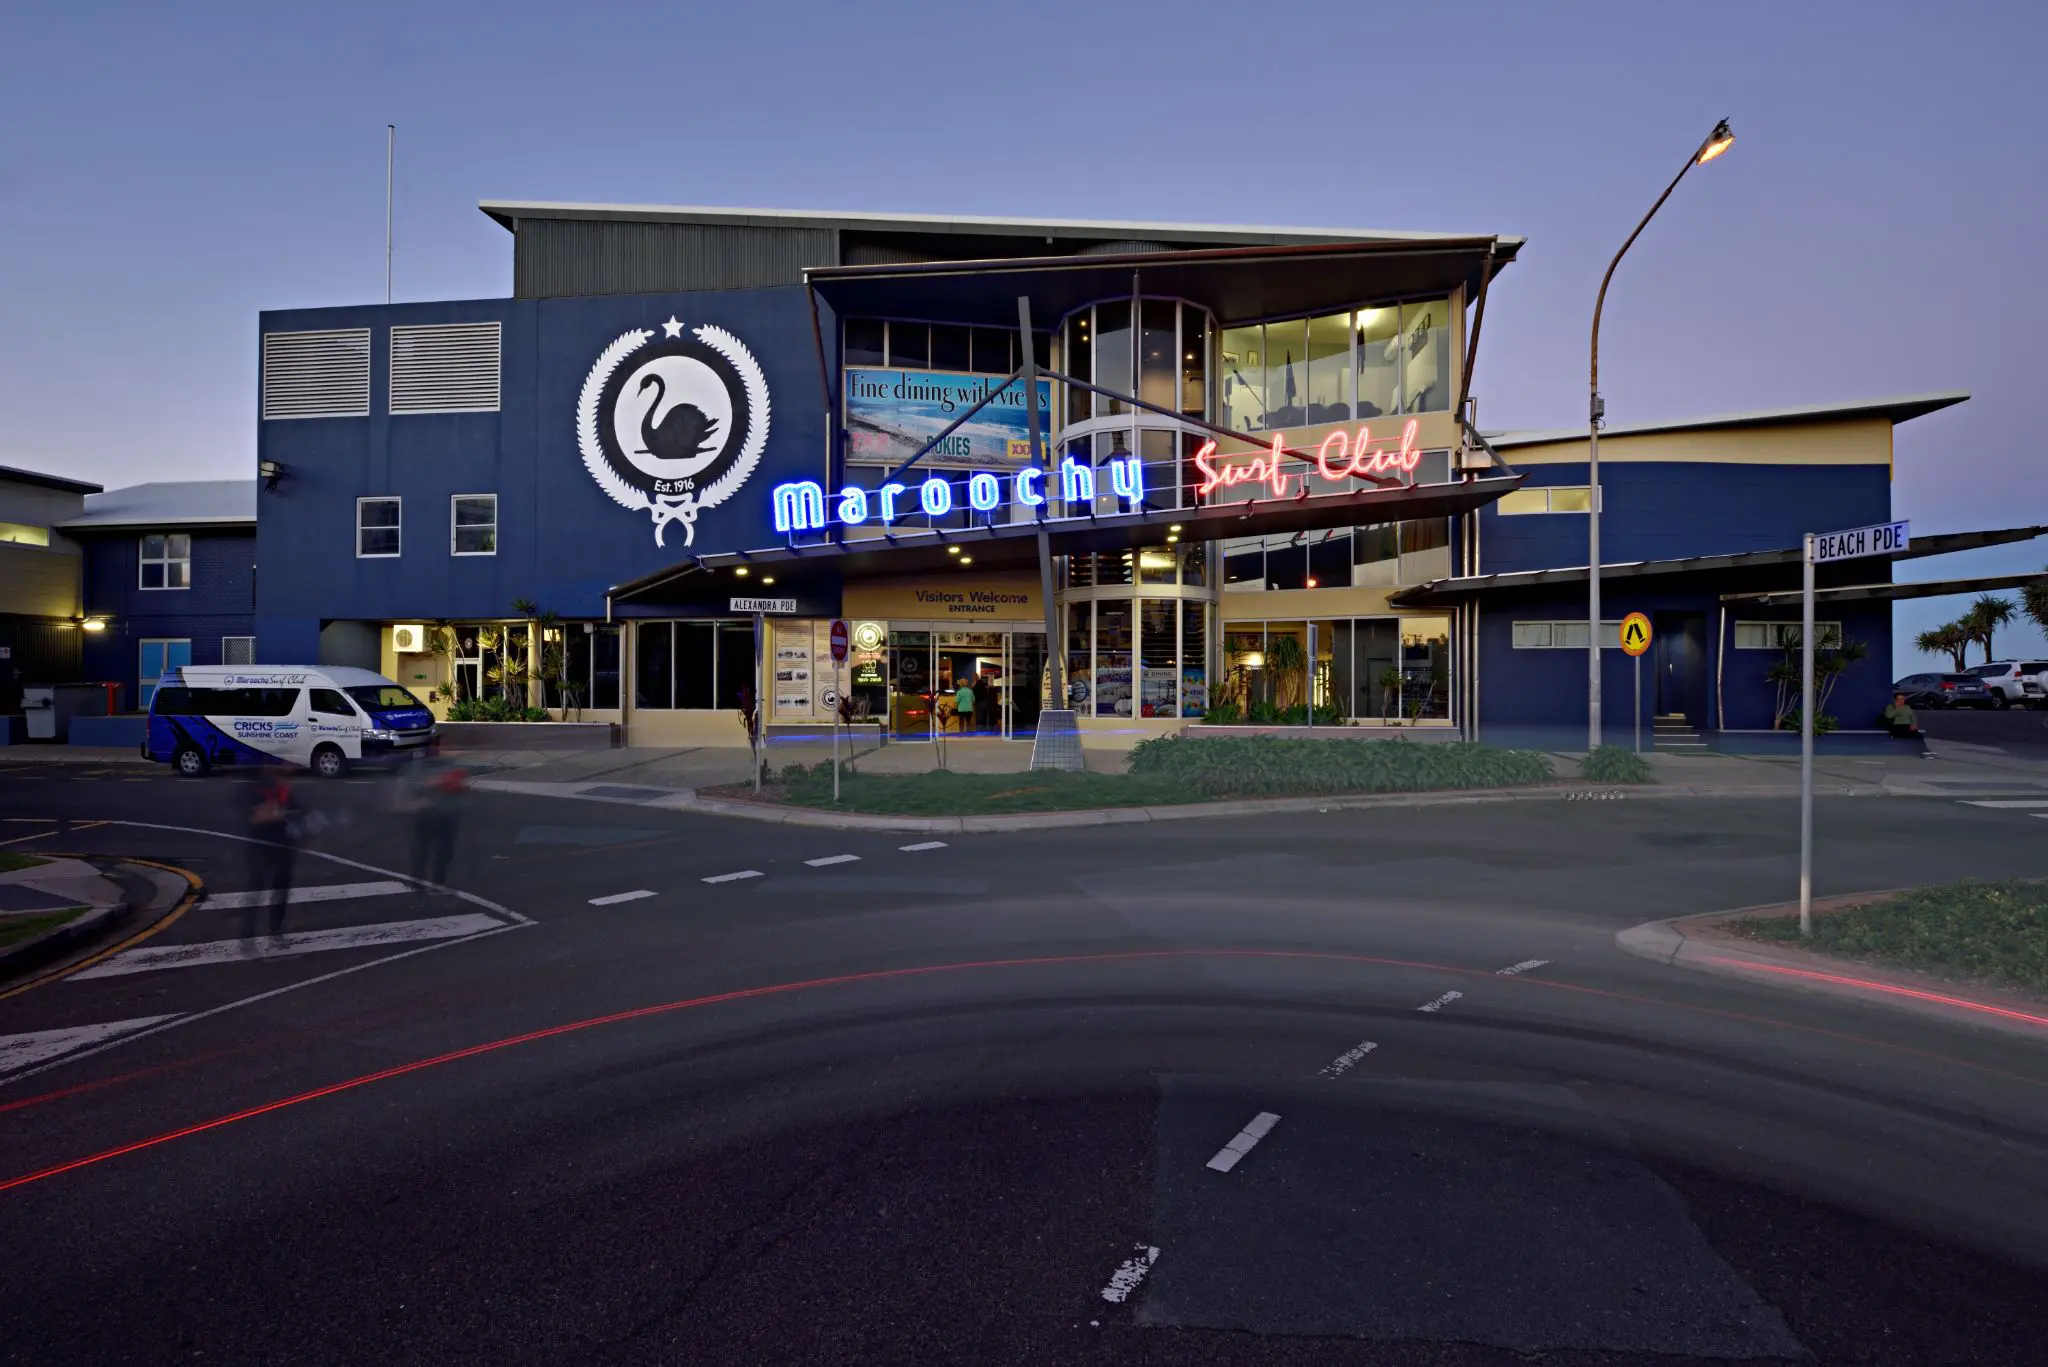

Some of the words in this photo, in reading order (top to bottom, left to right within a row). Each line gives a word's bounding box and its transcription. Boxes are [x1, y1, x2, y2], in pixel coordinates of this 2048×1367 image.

[851, 373, 889, 399] Fine
[894, 372, 955, 413] dining
[957, 378, 994, 405] with
[999, 381, 1048, 408] vies
[1194, 432, 1287, 496] Surf
[1318, 419, 1422, 480] Club
[654, 479, 673, 493] Est.
[674, 478, 695, 492] 1916
[773, 456, 1143, 532] maroochy
[1819, 531, 1865, 559] BEACH
[1873, 525, 1903, 551] PDE
[915, 590, 964, 603] Visitors
[969, 591, 1029, 604] Welcome
[734, 600, 777, 611] ALEXANDRA
[780, 601, 794, 611] PDE
[948, 604, 995, 613] ENTRANCE
[234, 721, 273, 731] CRICKS
